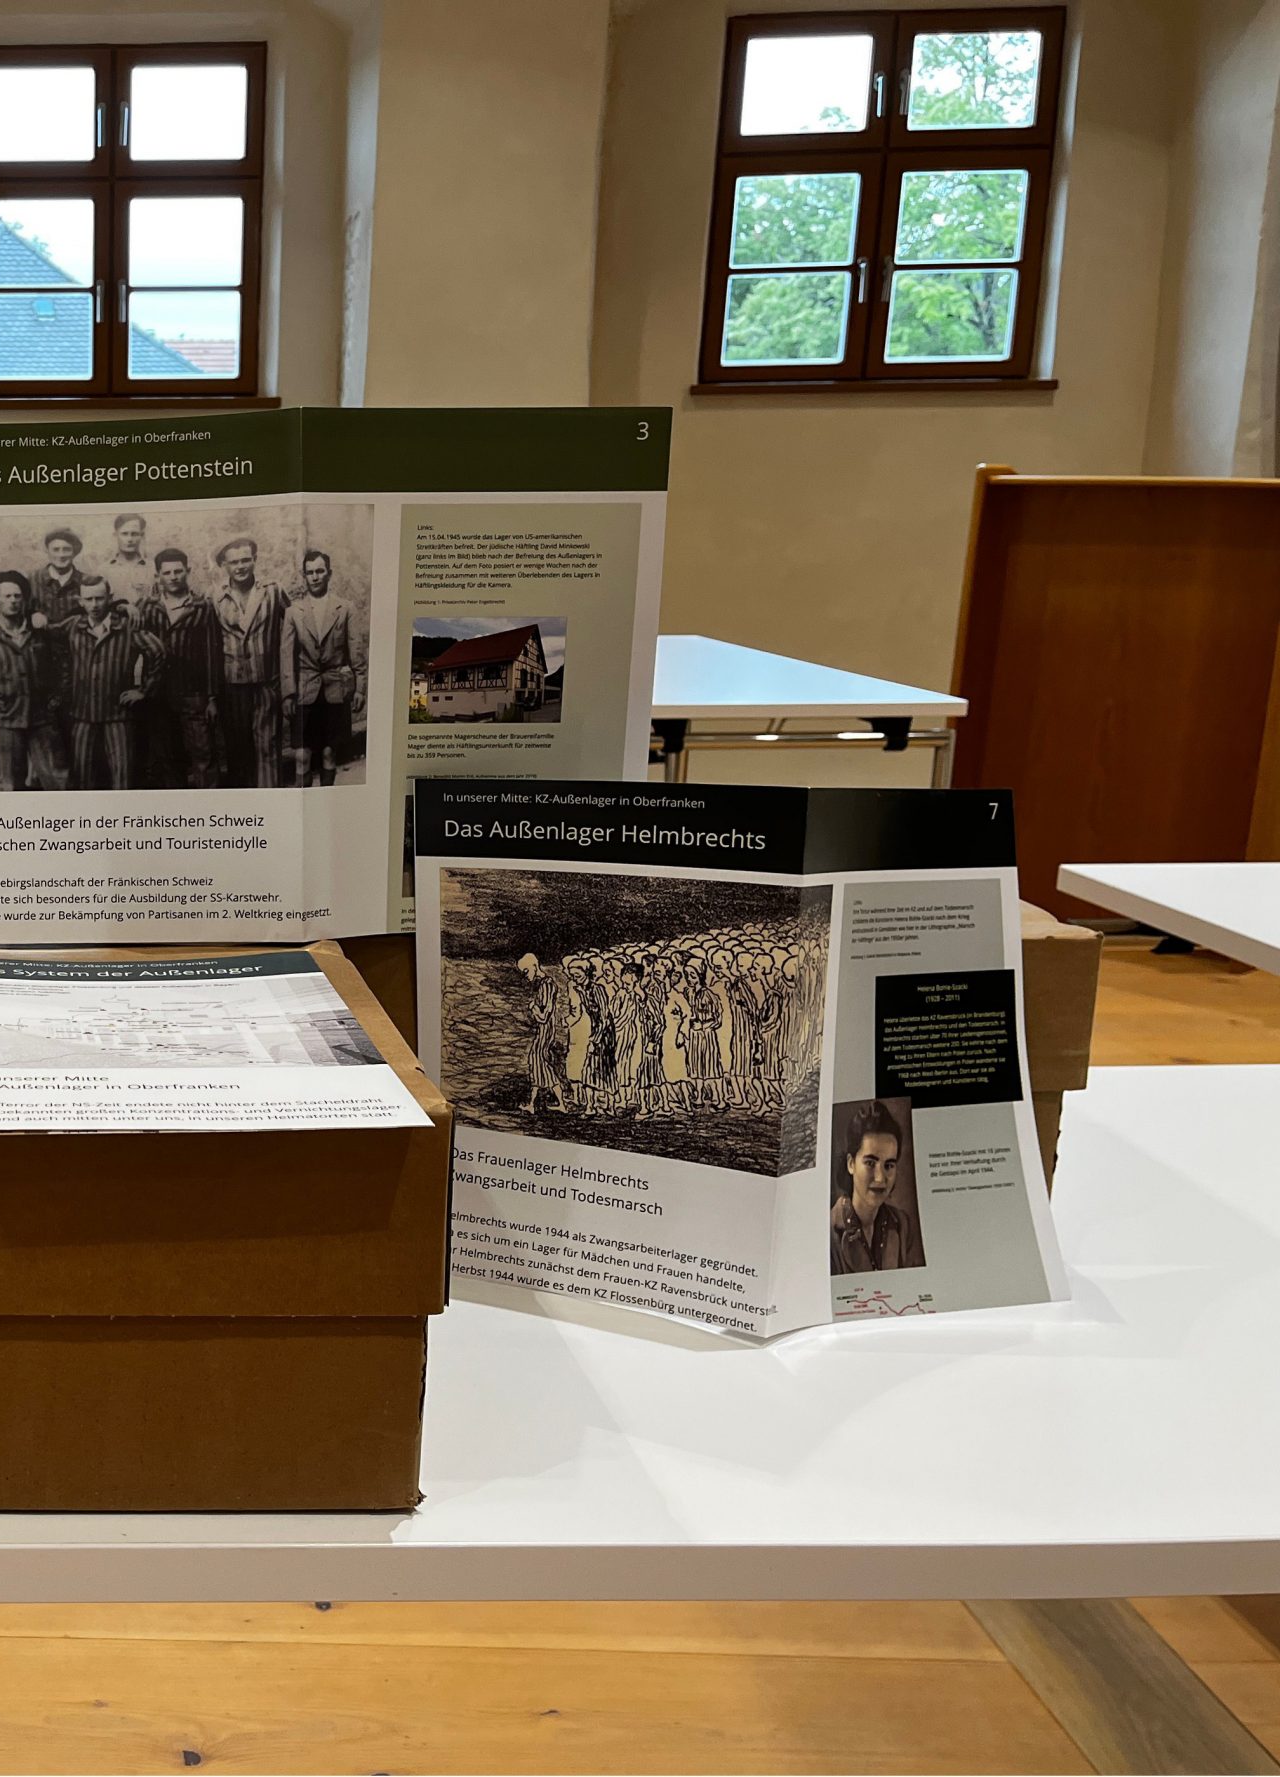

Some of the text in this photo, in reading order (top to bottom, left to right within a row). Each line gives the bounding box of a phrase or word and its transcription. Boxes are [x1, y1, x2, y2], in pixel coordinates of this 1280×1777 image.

[18, 436, 49, 447] Mitte:
[51, 434, 129, 447] KZ-Außenlager
[131, 434, 142, 444] in
[144, 430, 211, 443] Oberfranken
[636, 421, 649, 441] 3
[7, 463, 129, 488] Außenlager
[135, 456, 253, 481] Pottenstein
[443, 792, 705, 809] In unserer Mitte: KZ-Außenlager in Oberfranken
[988, 802, 999, 820] 7
[79, 816, 92, 829] in
[95, 815, 120, 829] der
[123, 814, 205, 828] Fränkischen
[209, 814, 265, 827] Schweiz
[445, 820, 766, 850] Das Außenlager Helmbrechts
[39, 837, 132, 854] Zwangsarbeit
[135, 836, 162, 851] und
[165, 836, 268, 853] Touristenidylle
[87, 877, 106, 888] der
[107, 876, 170, 887] Fränkischen
[172, 876, 214, 887] Schweiz
[13, 894, 34, 905] sich
[36, 893, 91, 904] besonders
[92, 893, 109, 904] für
[110, 893, 127, 904] die
[128, 893, 188, 906] Ausbildung
[189, 893, 208, 903] der
[210, 892, 282, 903] SS-Karstwehr.
[3, 910, 37, 921] wurde
[38, 912, 56, 921] zur
[58, 909, 124, 923] Bekämpfung
[125, 911, 145, 920] von
[148, 909, 204, 920] Partisanen
[206, 909, 220, 919] im
[221, 909, 231, 919] 2.
[233, 909, 284, 922] Weltkrieg
[285, 907, 332, 922] eingesetzt.
[12, 968, 90, 977] System
[139, 965, 263, 977] Außenlager
[477, 1151, 558, 1176] Frauenlager
[560, 1164, 649, 1191] Helmbrechts
[540, 1185, 567, 1199] und
[570, 1188, 663, 1216] Todesmarsch
[451, 1211, 758, 1278] elmbrechts wurde 1944 als Zwangsarbeiterlager gegründet.
[457, 1230, 469, 1240] es
[470, 1232, 491, 1243] sich
[493, 1237, 511, 1247] um
[513, 1239, 529, 1250] ein
[531, 1241, 561, 1256] Lager
[563, 1246, 579, 1258] für
[580, 1250, 630, 1268] Mädchen
[632, 1261, 654, 1272] und
[656, 1264, 693, 1281] Frauen
[695, 1272, 746, 1294] handelte,
[459, 1246, 525, 1267] Helmbrechts
[527, 1260, 575, 1276] zunächst
[576, 1267, 601, 1281] dem
[603, 1271, 658, 1291] Frauen-KZ
[660, 1282, 728, 1307] Ravensbrück
[451, 1262, 758, 1332] Herbst 1944 wurde es dem KZ Flossenbürg untergeordnet.
